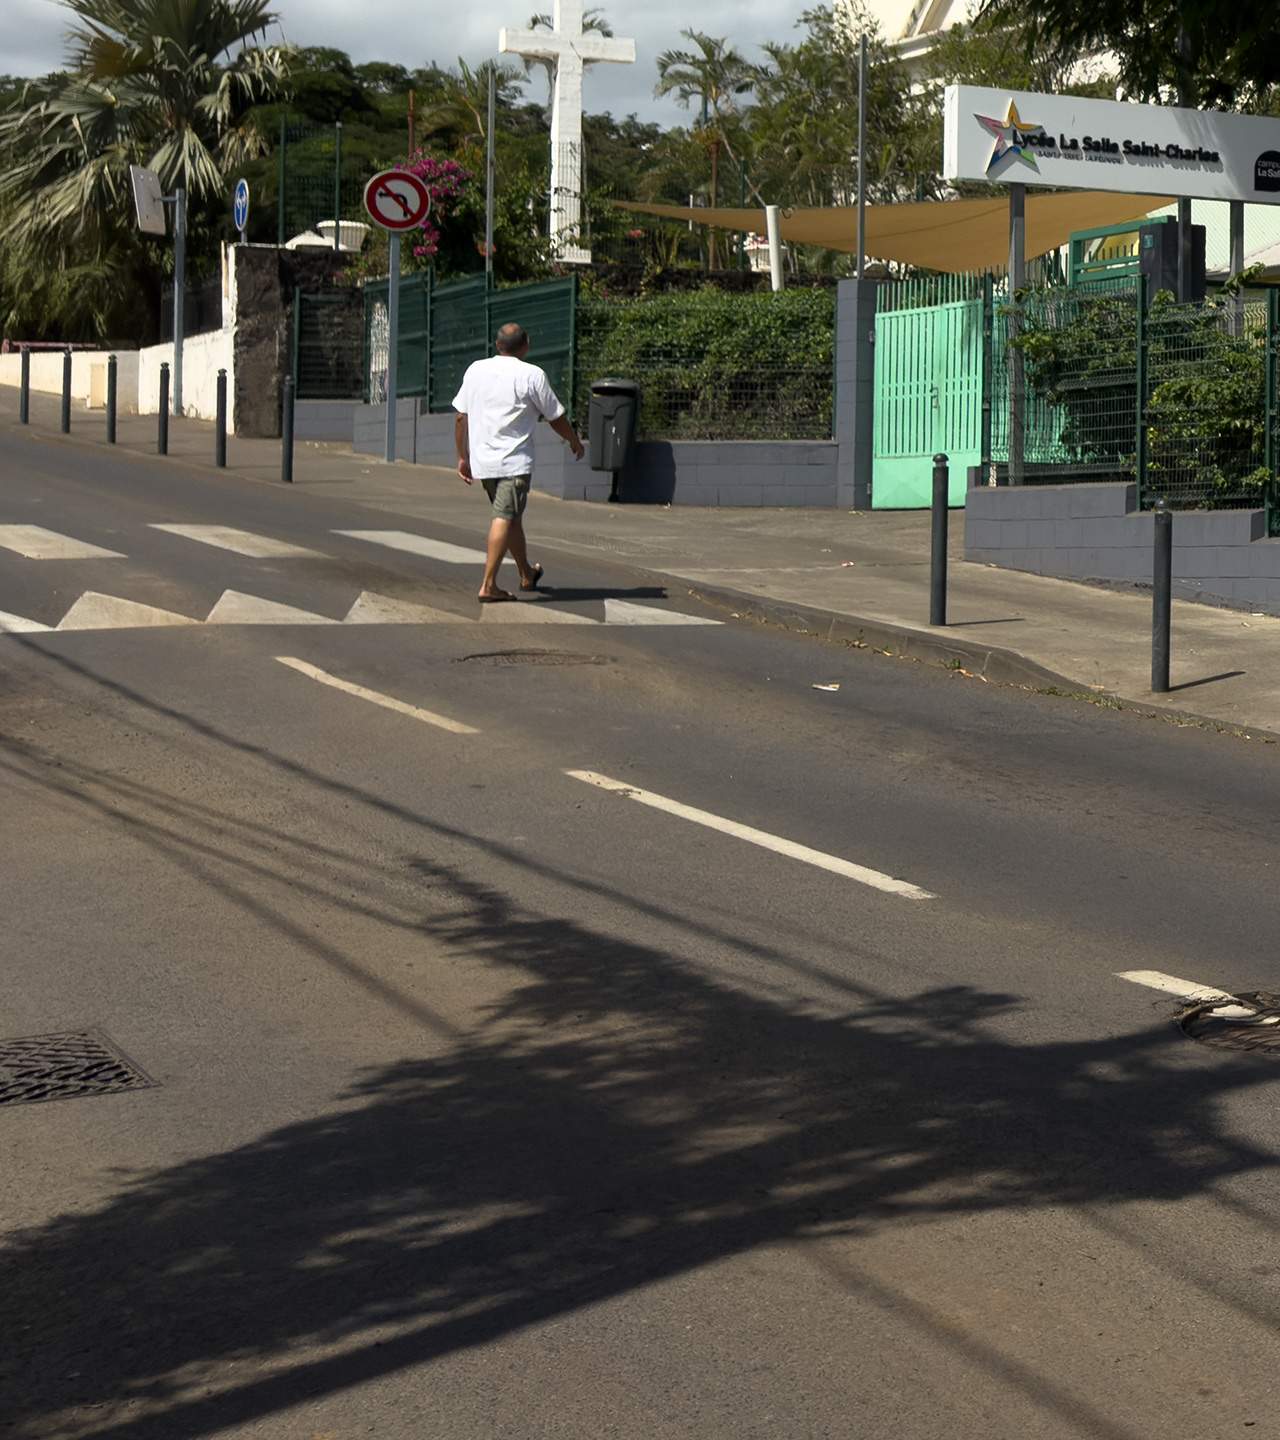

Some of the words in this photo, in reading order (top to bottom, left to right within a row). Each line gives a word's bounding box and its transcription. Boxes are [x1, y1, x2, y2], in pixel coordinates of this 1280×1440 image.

[1013, 129, 1056, 148] Lycée
[1060, 133, 1079, 150] La
[1082, 136, 1119, 153] Salle
[1122, 140, 1220, 162] Saint-Charles
[1258, 168, 1267, 177] La
